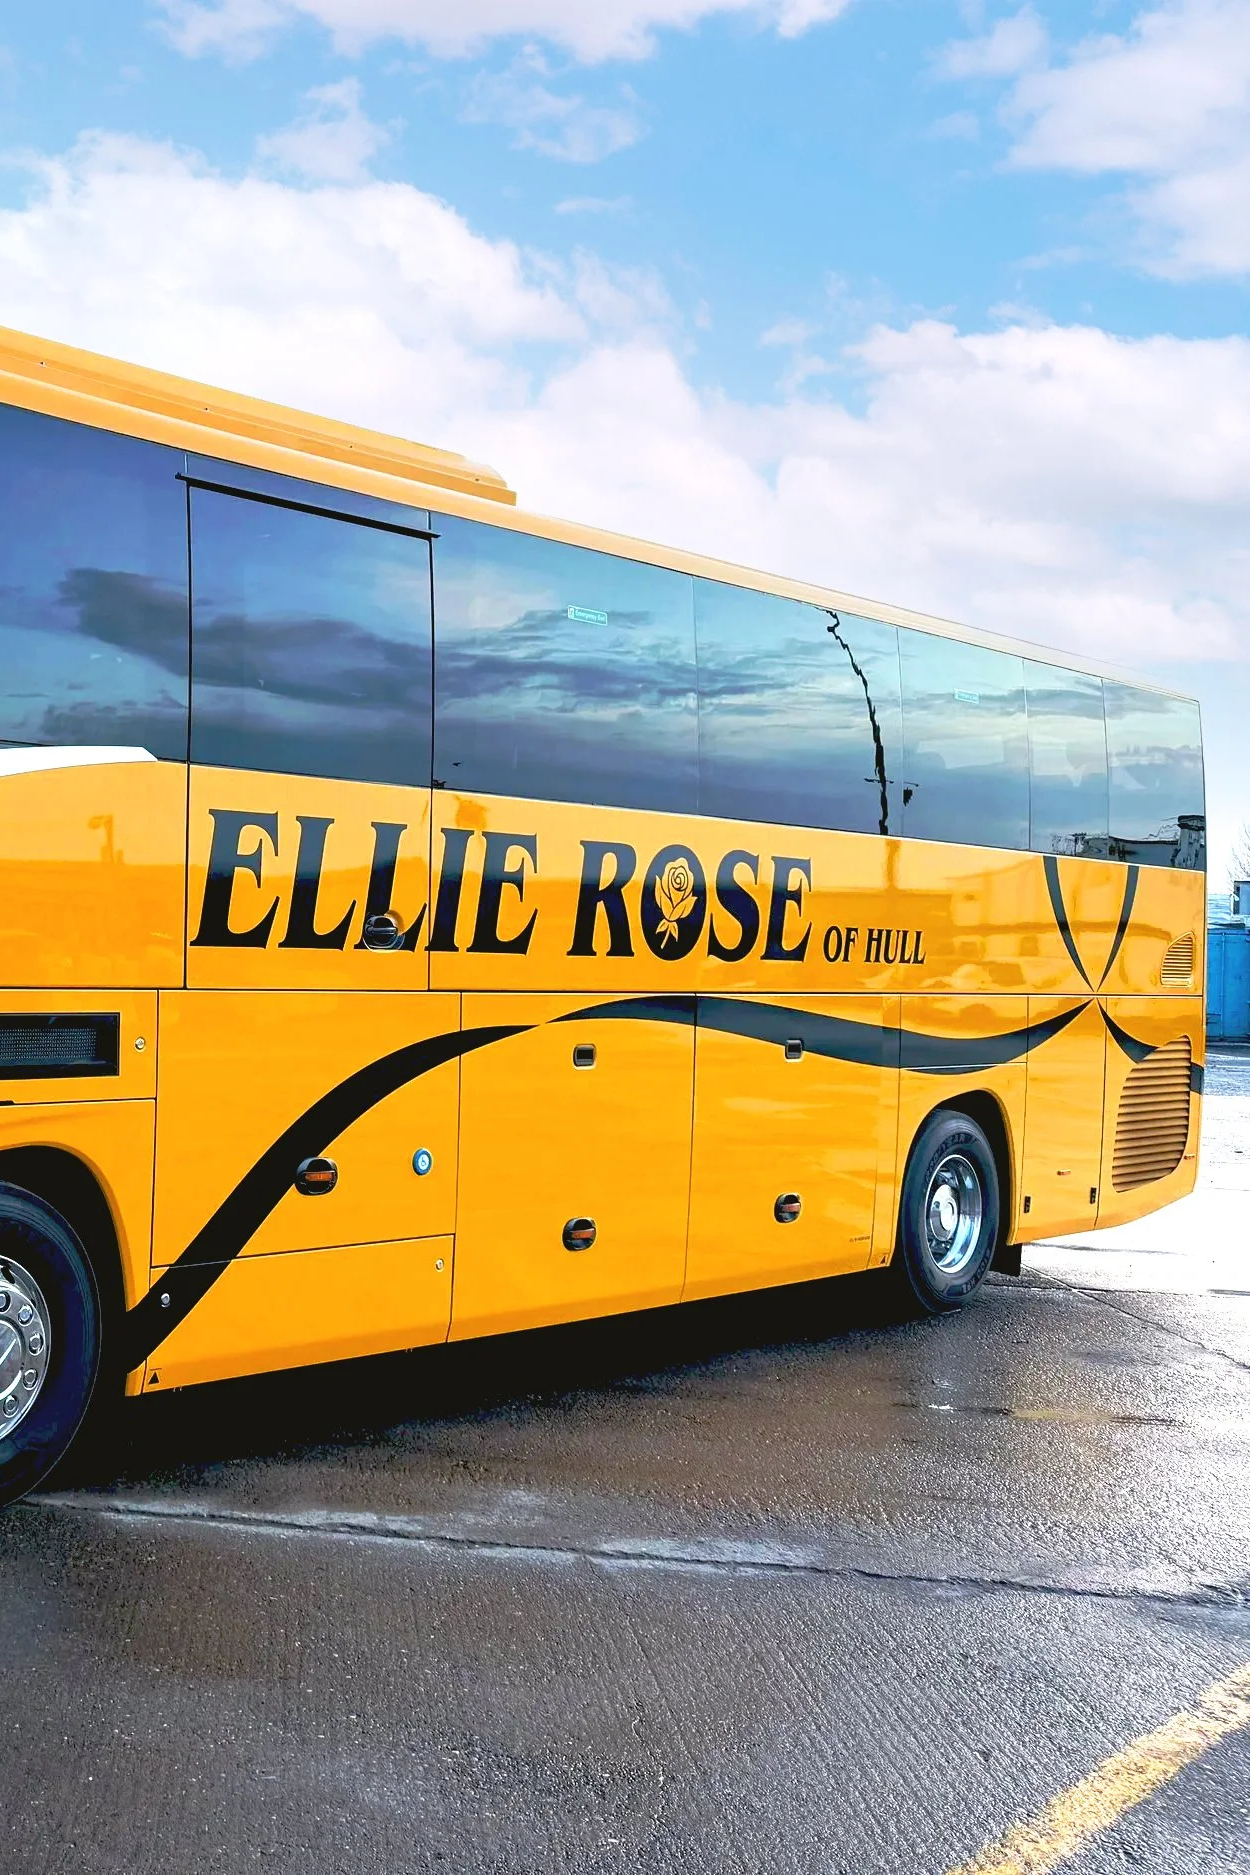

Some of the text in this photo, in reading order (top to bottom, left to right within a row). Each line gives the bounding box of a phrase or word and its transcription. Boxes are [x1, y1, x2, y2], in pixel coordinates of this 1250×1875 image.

[190, 808, 926, 965] ELLIE ROSE OF HULL
